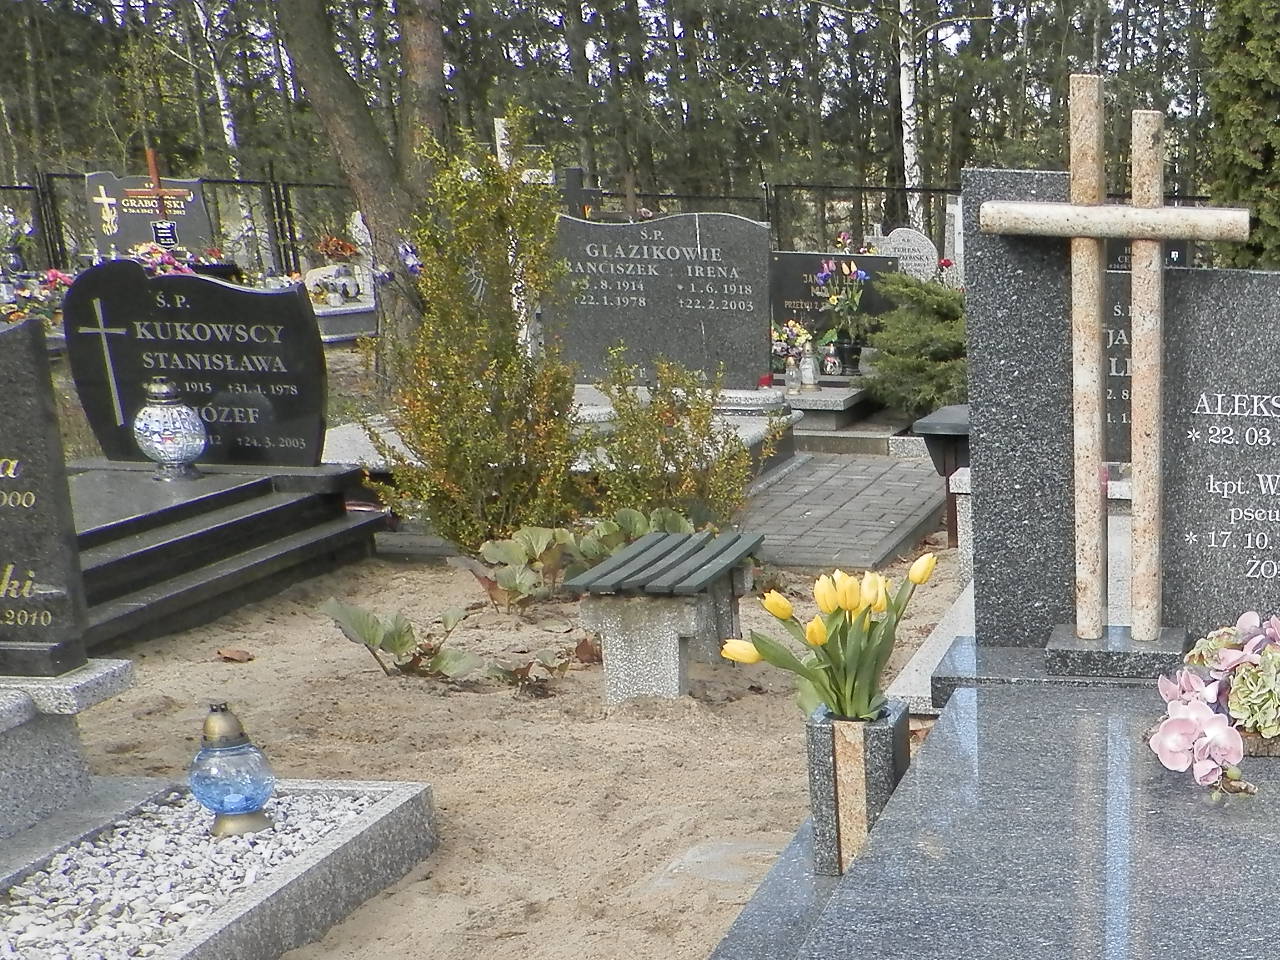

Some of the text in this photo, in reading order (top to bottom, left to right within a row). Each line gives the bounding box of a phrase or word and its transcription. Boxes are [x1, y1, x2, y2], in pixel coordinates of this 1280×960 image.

[121, 199, 185, 209] GRABOSKI
[563, 260, 739, 278] RANCISZEK IRENA
[132, 320, 285, 344] KUKOWSCY
[142, 352, 288, 373] STANISŁAWA
[1207, 474, 1250, 499] kpt.
